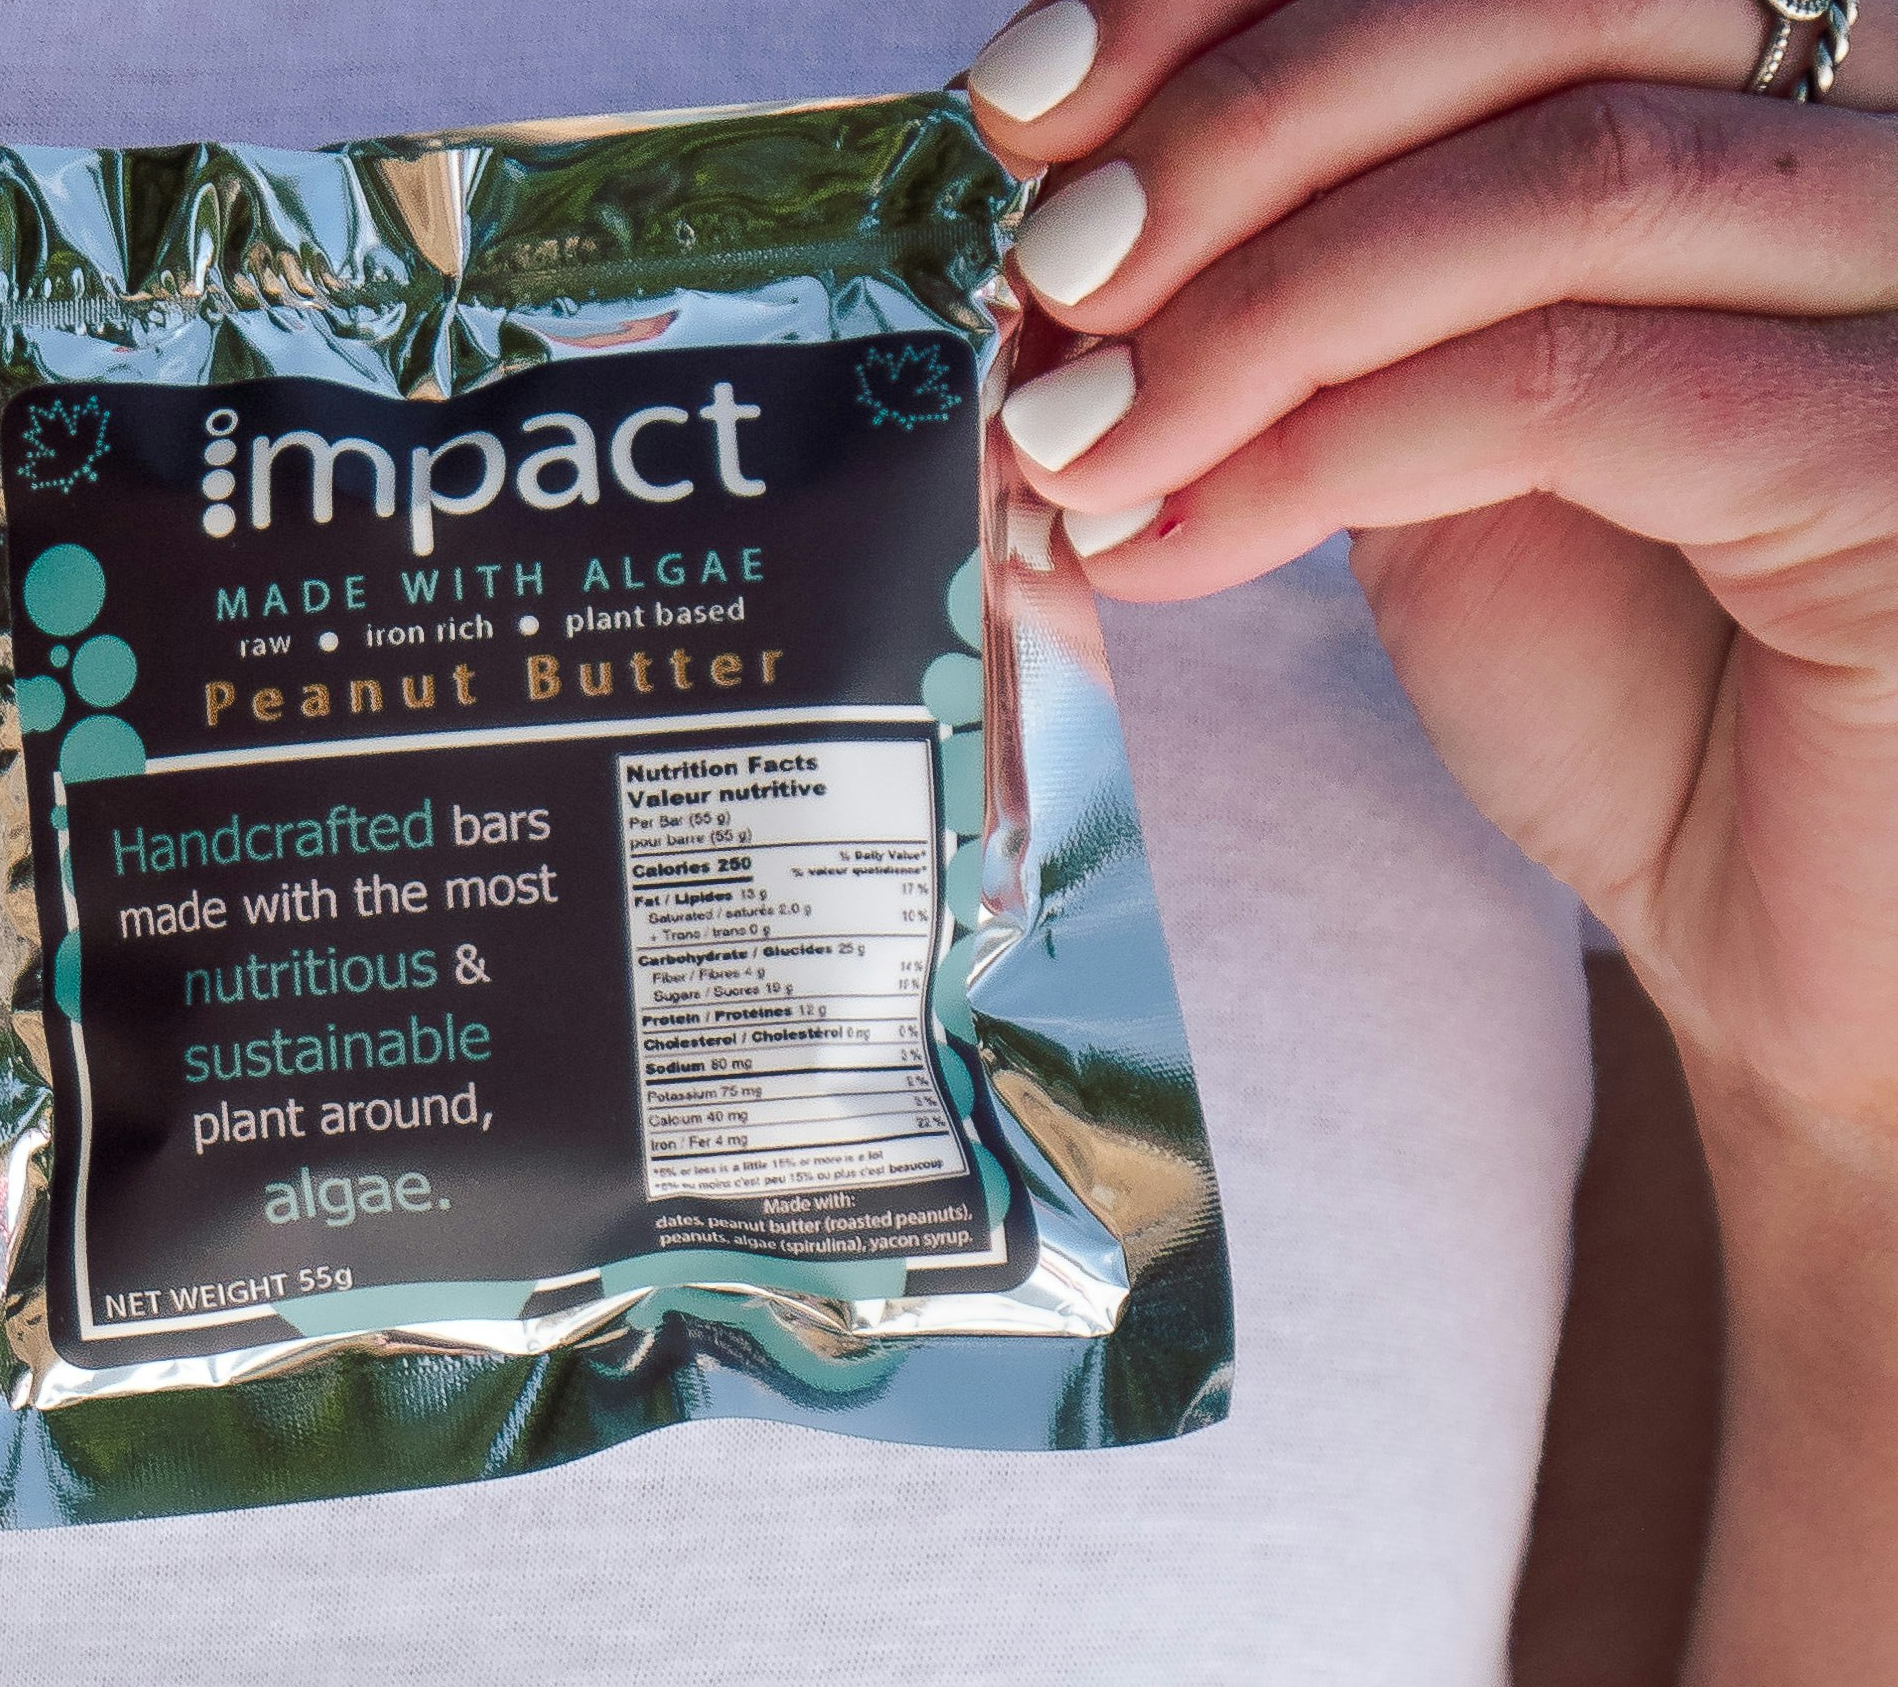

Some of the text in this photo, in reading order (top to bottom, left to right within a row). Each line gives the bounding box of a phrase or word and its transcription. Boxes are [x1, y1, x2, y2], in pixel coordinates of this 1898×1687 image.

[202, 381, 766, 557] impact
[215, 547, 766, 622] MADE WITH ALGAE
[239, 596, 746, 660] raw iron rich plant based
[204, 647, 783, 726] Peanut Butter
[626, 754, 819, 784] Nutrition Facts
[627, 779, 827, 809] Valeur nutritive
[629, 810, 731, 829] Per Bar (55 g)
[112, 797, 551, 877] Handcrafted bars
[710, 829, 734, 846] (55
[738, 827, 752, 844] g)
[632, 856, 751, 878] Calories 250
[855, 850, 885, 862] Daily
[118, 864, 558, 939] made with the most
[634, 895, 660, 907] Fat
[675, 891, 733, 906] Lipides
[638, 949, 747, 967] Carbohydrate
[763, 944, 833, 957] Glucides
[185, 943, 492, 1007] nutritious &
[642, 1013, 700, 1027] Protein
[184, 1012, 491, 1084] sustainable
[643, 1033, 736, 1052] Cholesterol
[645, 1061, 706, 1076] Sodium
[732, 1058, 753, 1072] mg
[647, 1088, 717, 1102] Potassium
[741, 1085, 763, 1099] mg
[193, 1081, 493, 1155] plant around,
[727, 1110, 749, 1124] mg
[651, 1139, 677, 1151] Iron
[689, 1136, 711, 1148] Fer
[727, 1134, 749, 1147] mg
[263, 1166, 452, 1228] algae.
[763, 1192, 857, 1214] Made with:
[655, 1203, 973, 1234] dates, peanut butter (roasted peanuts),
[659, 1229, 973, 1255] peanuts, algae (spirulina), yacon syrup.
[105, 1264, 354, 1320] NET WEIGHT 55g
